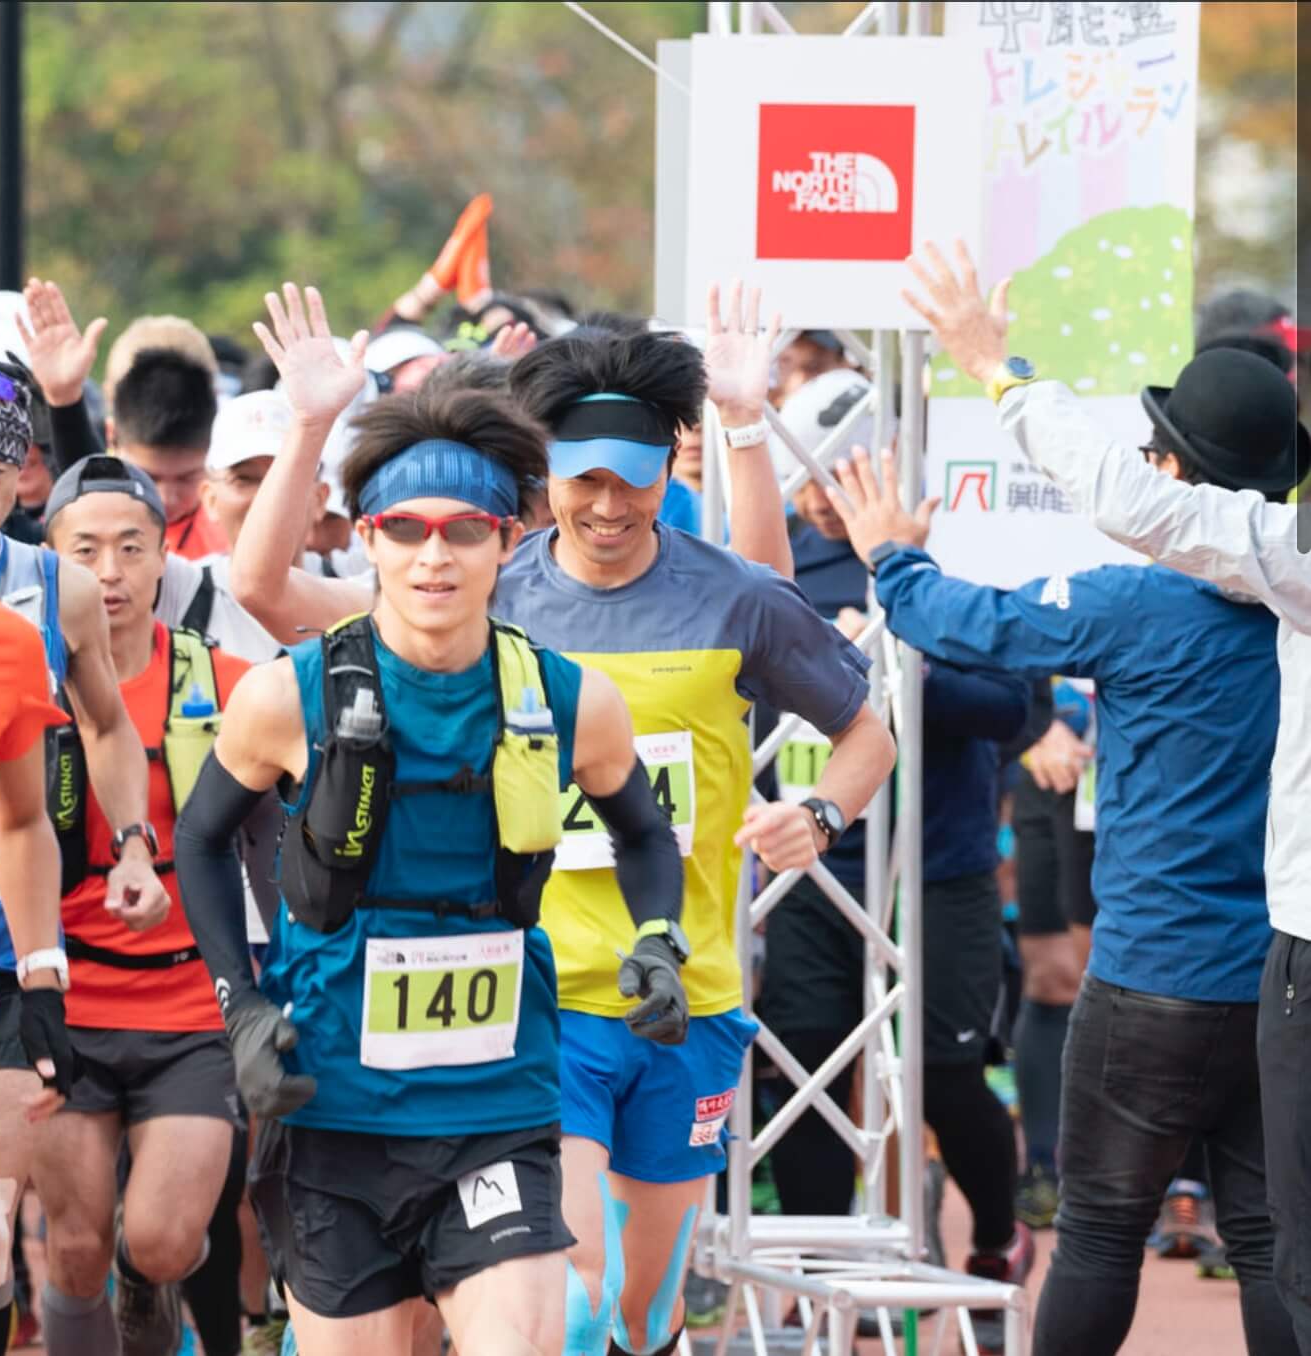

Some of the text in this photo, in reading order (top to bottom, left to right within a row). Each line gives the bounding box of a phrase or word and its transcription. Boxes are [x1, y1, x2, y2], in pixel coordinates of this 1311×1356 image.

[809, 152, 855, 173] THE
[772, 171, 855, 192] NORTH
[794, 192, 855, 213] FACE
[393, 968, 499, 1030] 140
